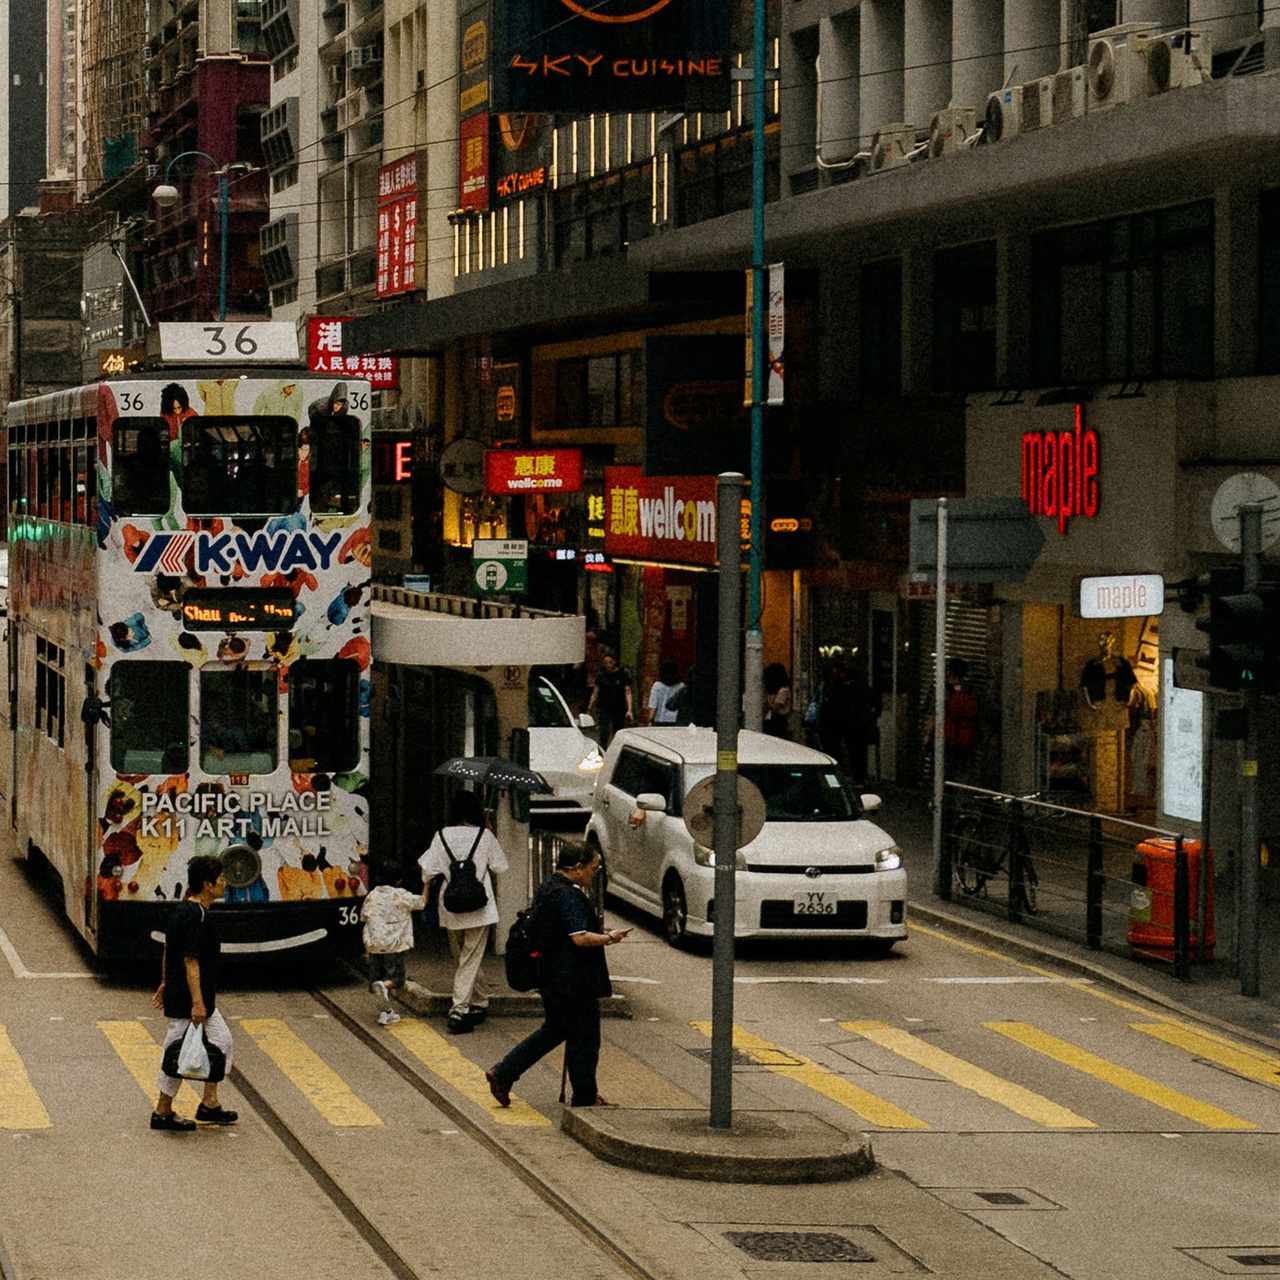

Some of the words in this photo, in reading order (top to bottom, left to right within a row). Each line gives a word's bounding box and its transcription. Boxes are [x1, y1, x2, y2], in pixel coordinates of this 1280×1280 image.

[510, 54, 603, 77] SKY
[613, 59, 723, 77] CUISINE
[497, 172, 518, 197] SKY
[202, 326, 258, 357] 36
[119, 393, 145, 412] 36
[349, 392, 370, 412] 36
[514, 454, 556, 476] 惠康
[1021, 403, 1098, 535] maple
[507, 477, 563, 489] wellcome
[610, 485, 639, 536] 惠康
[638, 486, 716, 542] wellcom
[1096, 579, 1147, 612] maple
[141, 792, 242, 814] PACIFIC
[249, 791, 331, 813] PLACE
[141, 817, 187, 839] K11
[196, 817, 253, 839] ART
[260, 815, 331, 837] MALL
[797, 902, 834, 914] 2636
[807, 892, 825, 902] YV
[338, 906, 359, 926] 36
